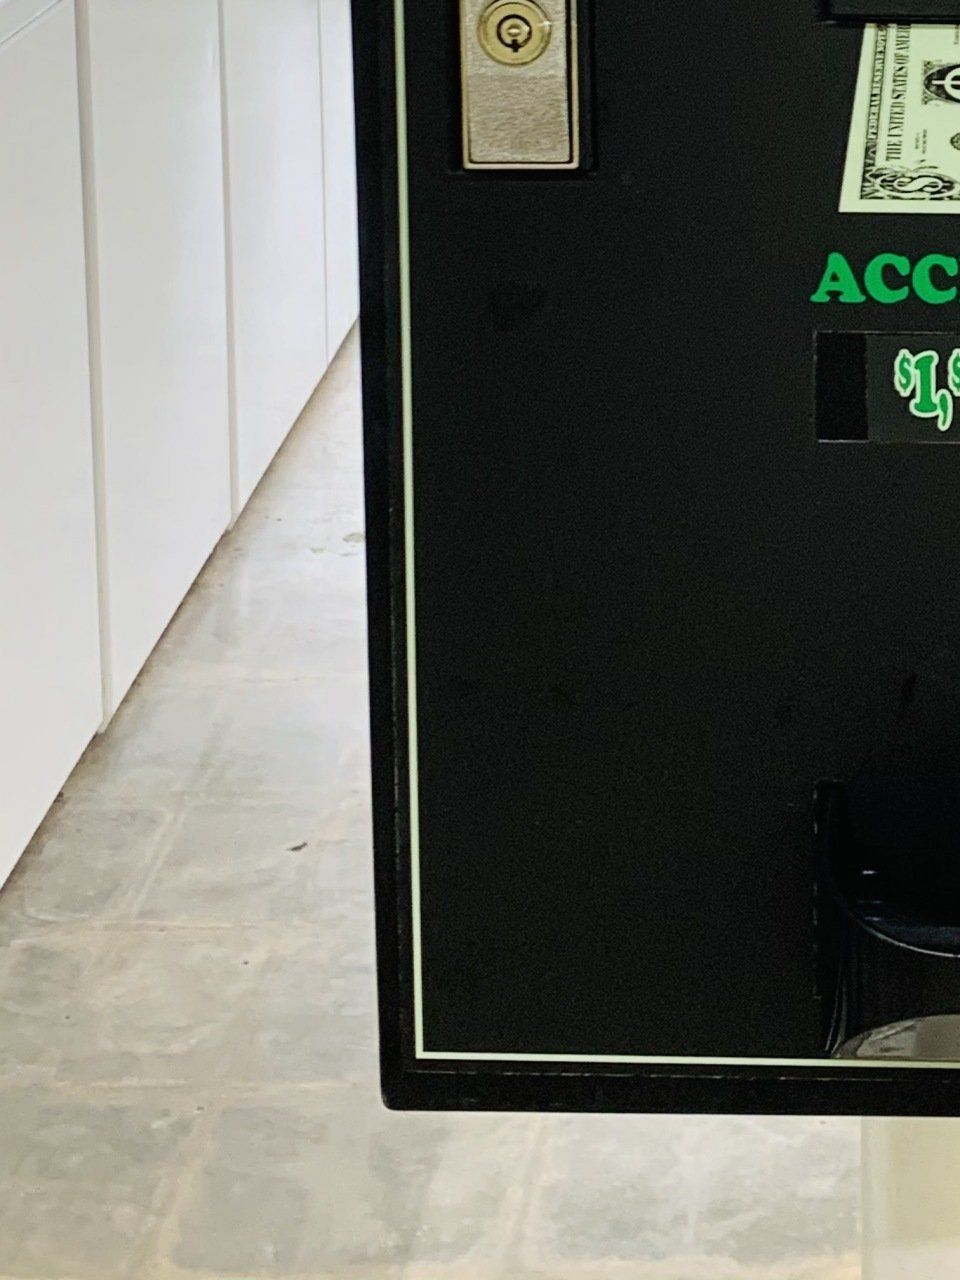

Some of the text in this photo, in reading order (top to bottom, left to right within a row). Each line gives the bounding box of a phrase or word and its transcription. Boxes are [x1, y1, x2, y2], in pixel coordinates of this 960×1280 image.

[894, 53, 909, 65] OF
[891, 66, 908, 99] STATES
[888, 101, 904, 137] UNITED
[886, 140, 902, 162] THE
